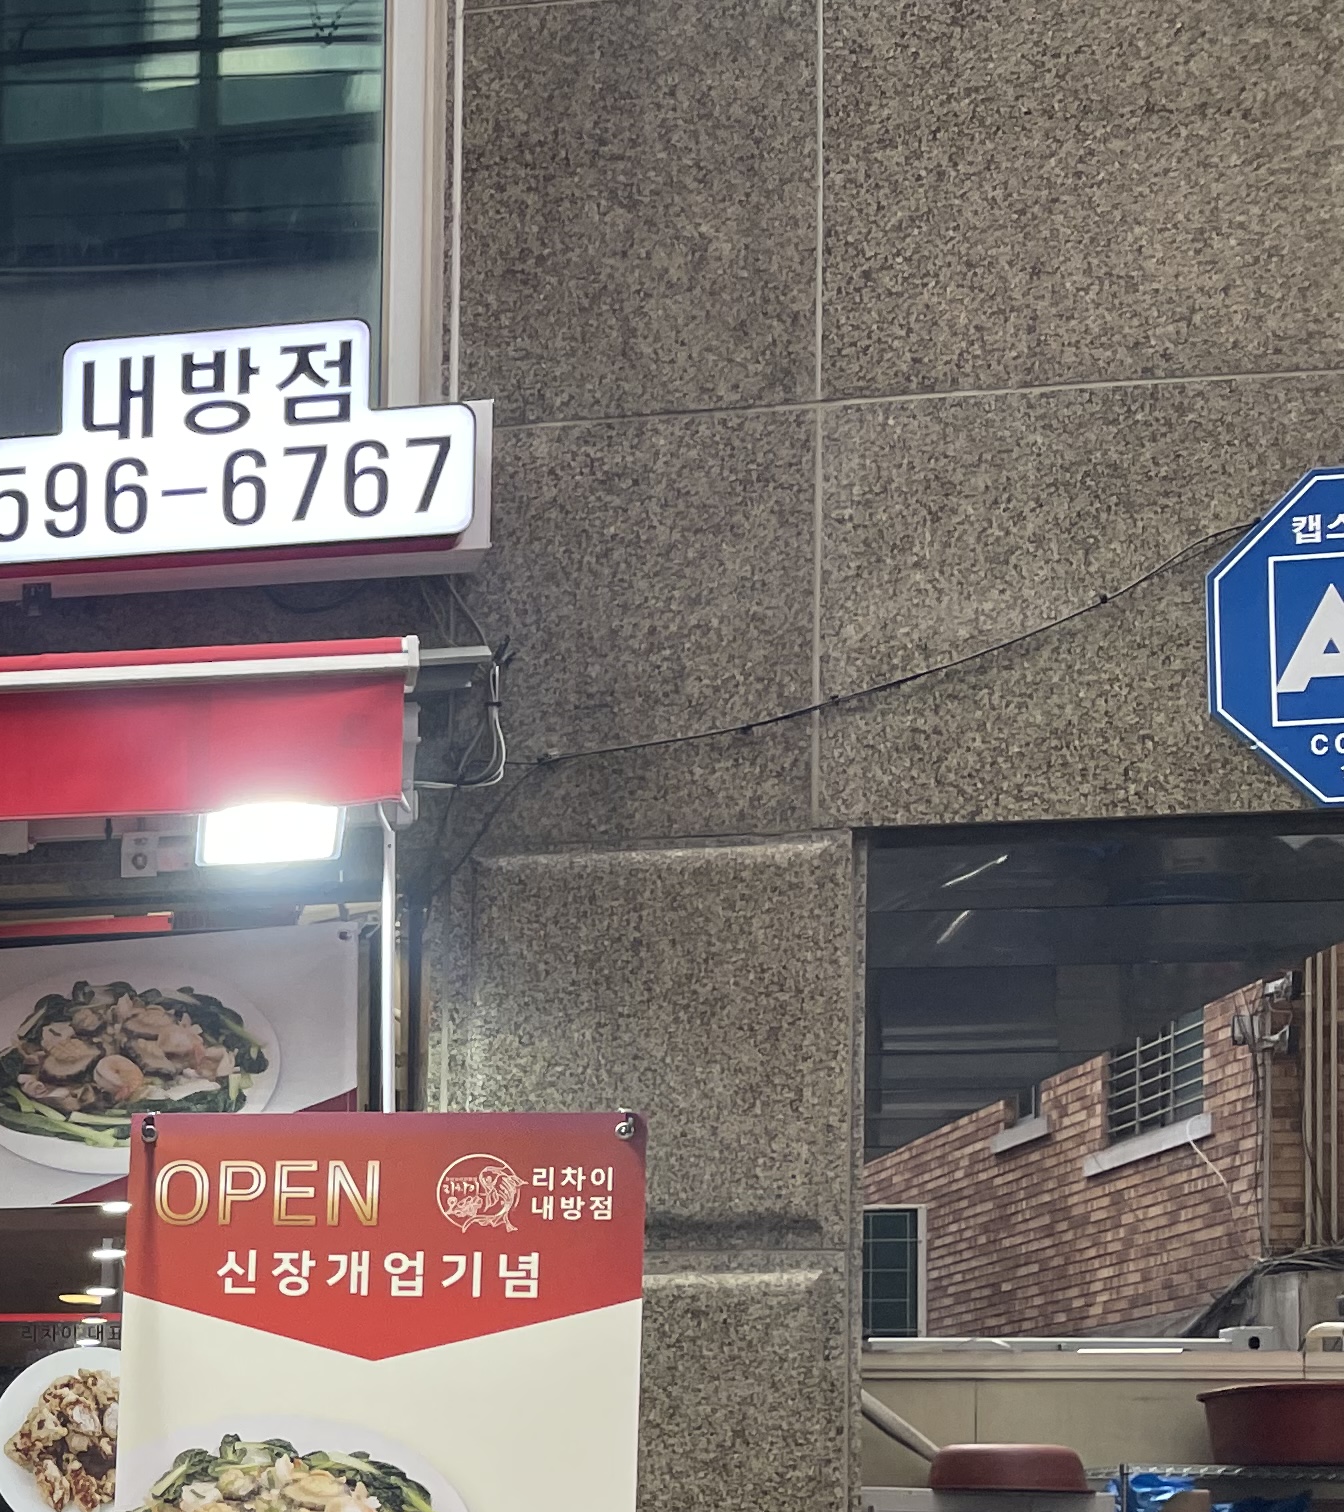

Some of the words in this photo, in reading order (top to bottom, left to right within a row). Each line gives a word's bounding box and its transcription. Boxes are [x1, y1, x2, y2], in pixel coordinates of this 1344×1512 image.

[82, 339, 353, 440] 내방점
[154, 1159, 381, 1228] OPEN
[531, 1166, 615, 1190] 리차이
[531, 1195, 614, 1220] 내방점
[217, 1250, 541, 1298] 신장개업기념
